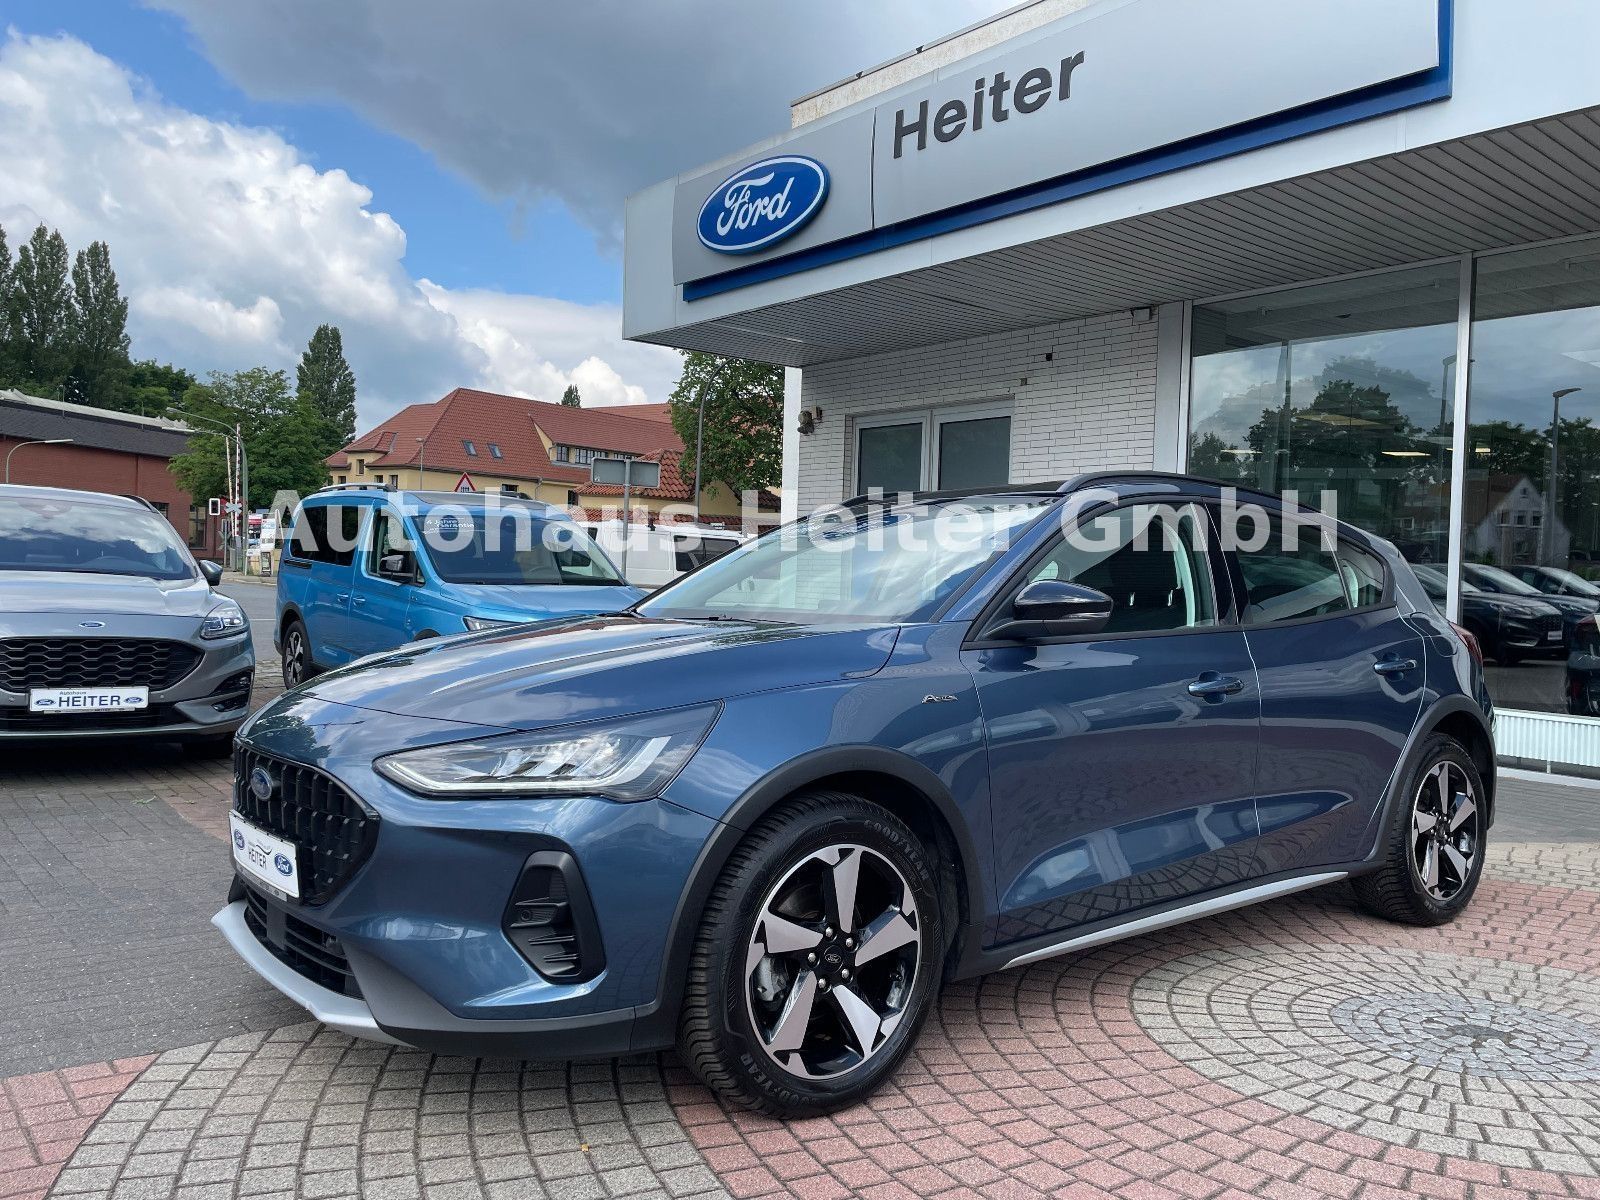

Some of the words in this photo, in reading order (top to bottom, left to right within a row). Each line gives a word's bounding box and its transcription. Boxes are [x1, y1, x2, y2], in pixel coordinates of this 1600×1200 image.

[892, 50, 1085, 160] Heiter
[715, 172, 794, 237] Ford
[58, 695, 121, 708] HEITER
